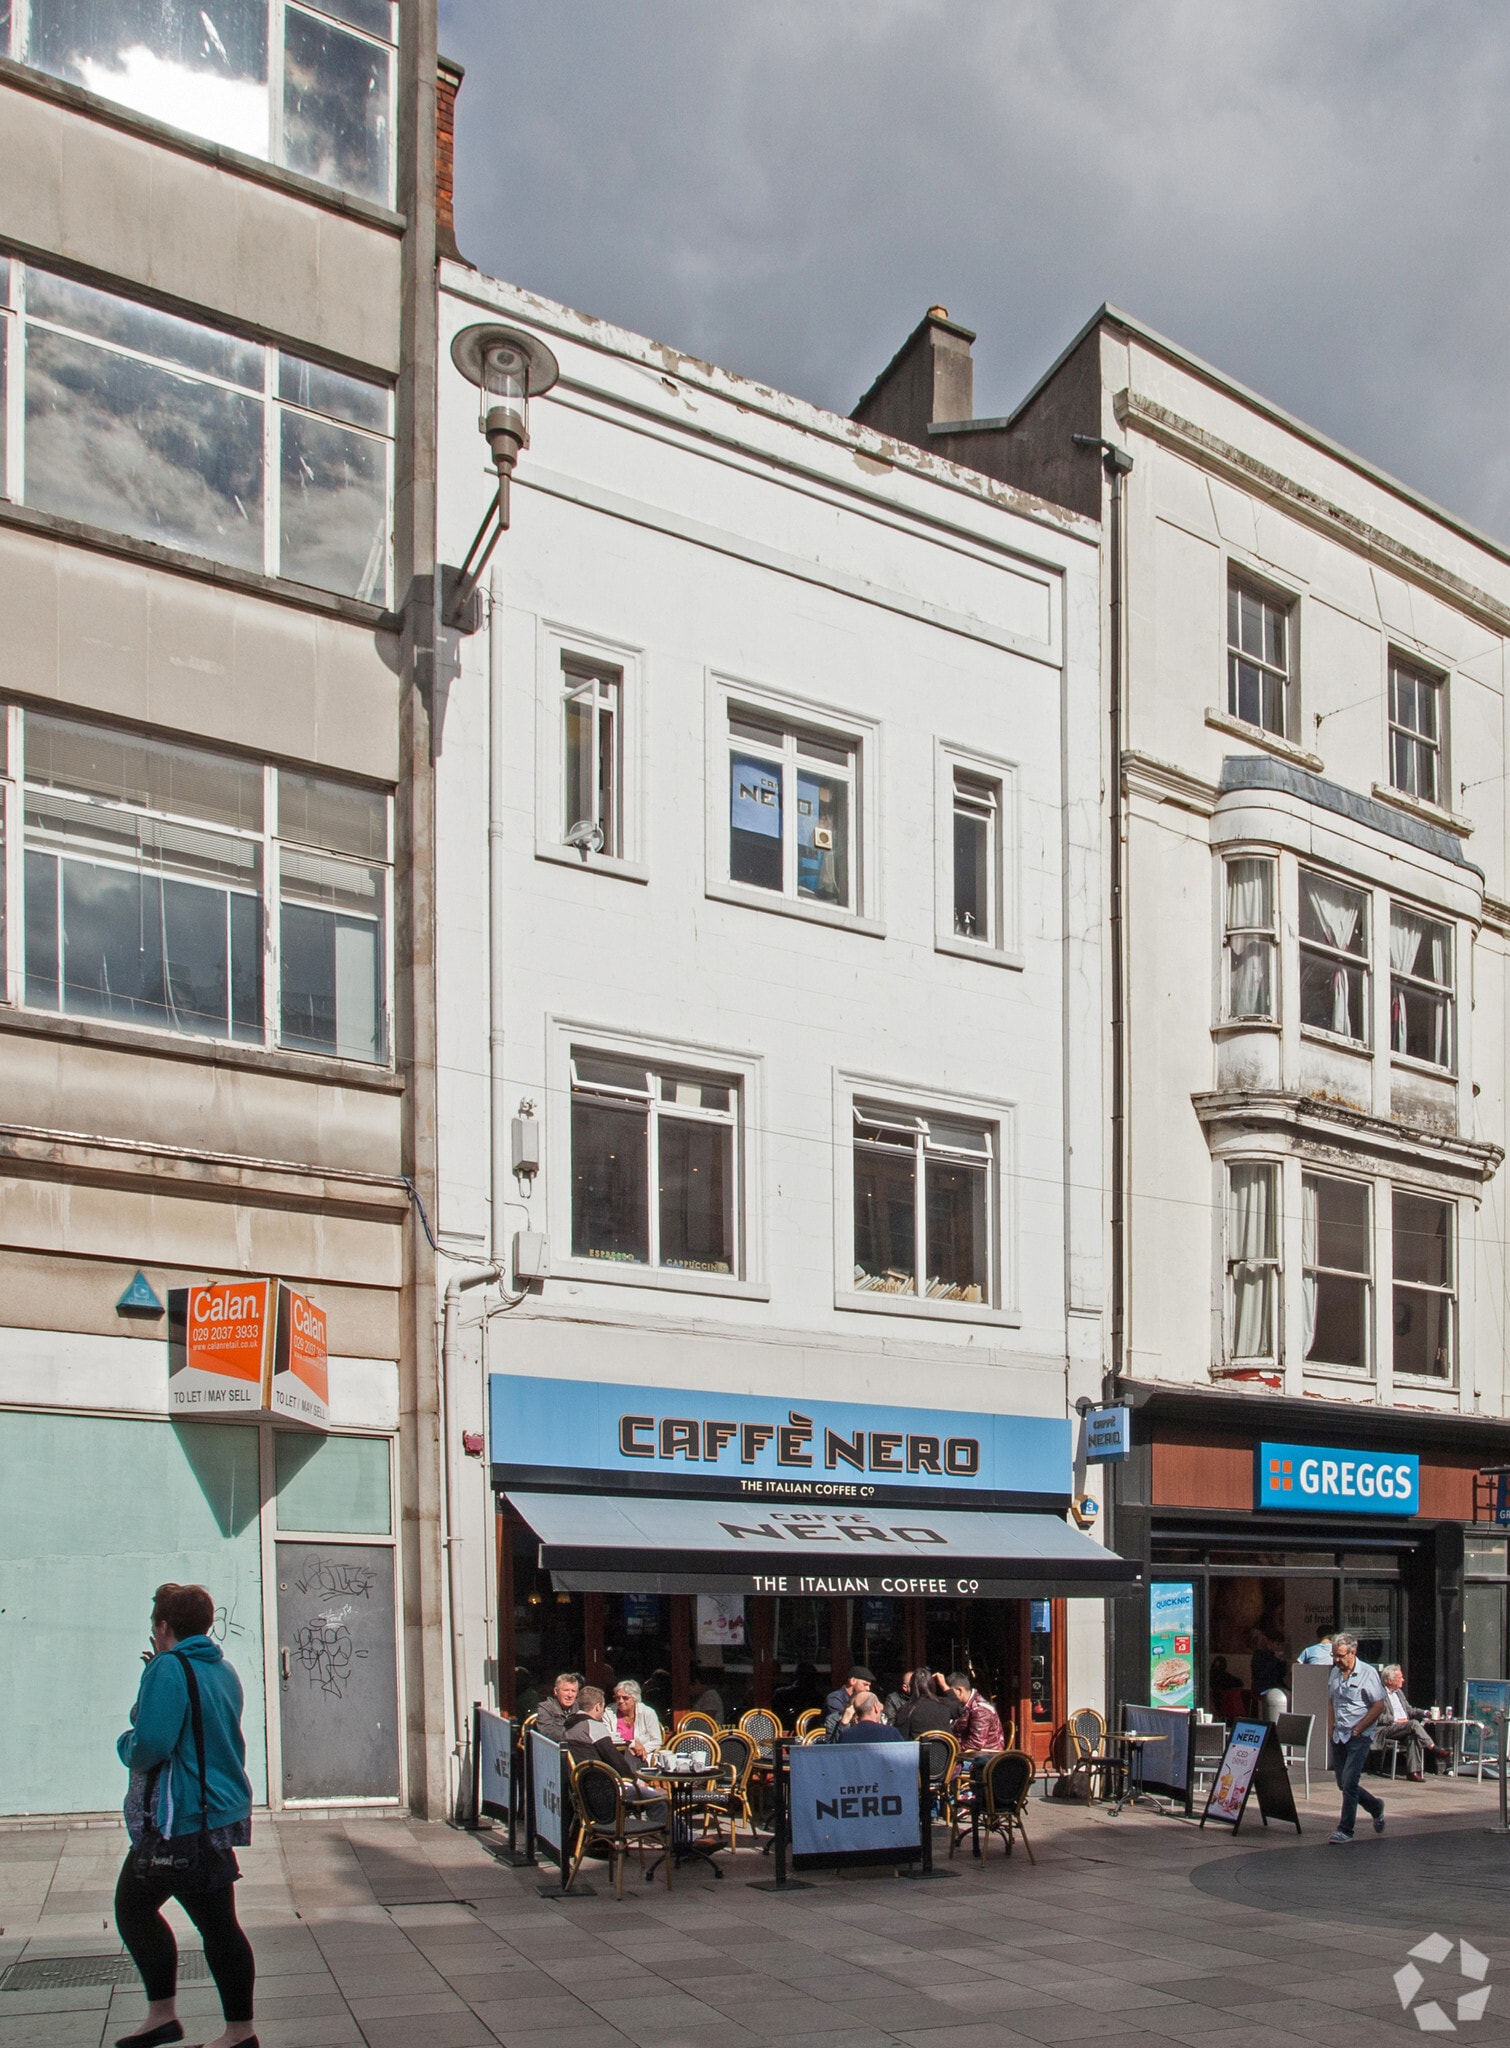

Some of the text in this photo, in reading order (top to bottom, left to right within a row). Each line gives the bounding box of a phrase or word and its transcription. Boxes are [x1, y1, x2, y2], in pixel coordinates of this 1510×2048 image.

[194, 1290, 259, 1322] Calan.
[193, 1325, 258, 1341] 029 2037 3933
[174, 1391, 186, 1404] TO
[186, 1390, 202, 1403] LET
[208, 1389, 227, 1402] MAY
[228, 1390, 251, 1402] SELL
[276, 1390, 285, 1405] TO
[285, 1394, 297, 1409] LET
[301, 1401, 314, 1416] MAY
[314, 1405, 326, 1420] SELL
[619, 1410, 980, 1476] CAFFÈ NERO
[1088, 1432, 1121, 1447] NERO
[740, 1479, 764, 1493] THE
[765, 1481, 812, 1495] ITALIAN
[815, 1483, 858, 1497] COFFEE
[1300, 1458, 1412, 1500] GREGGS
[717, 1520, 949, 1545] NERO
[753, 1576, 788, 1592] THE
[800, 1577, 869, 1593] ITALIAN
[881, 1578, 948, 1594] COFFEE
[1304, 1603, 1334, 1613] Welcom
[1351, 1602, 1365, 1614] the
[1304, 1614, 1312, 1624] of
[1237, 1733, 1260, 1744] NERO
[815, 1794, 903, 1821] NERO
